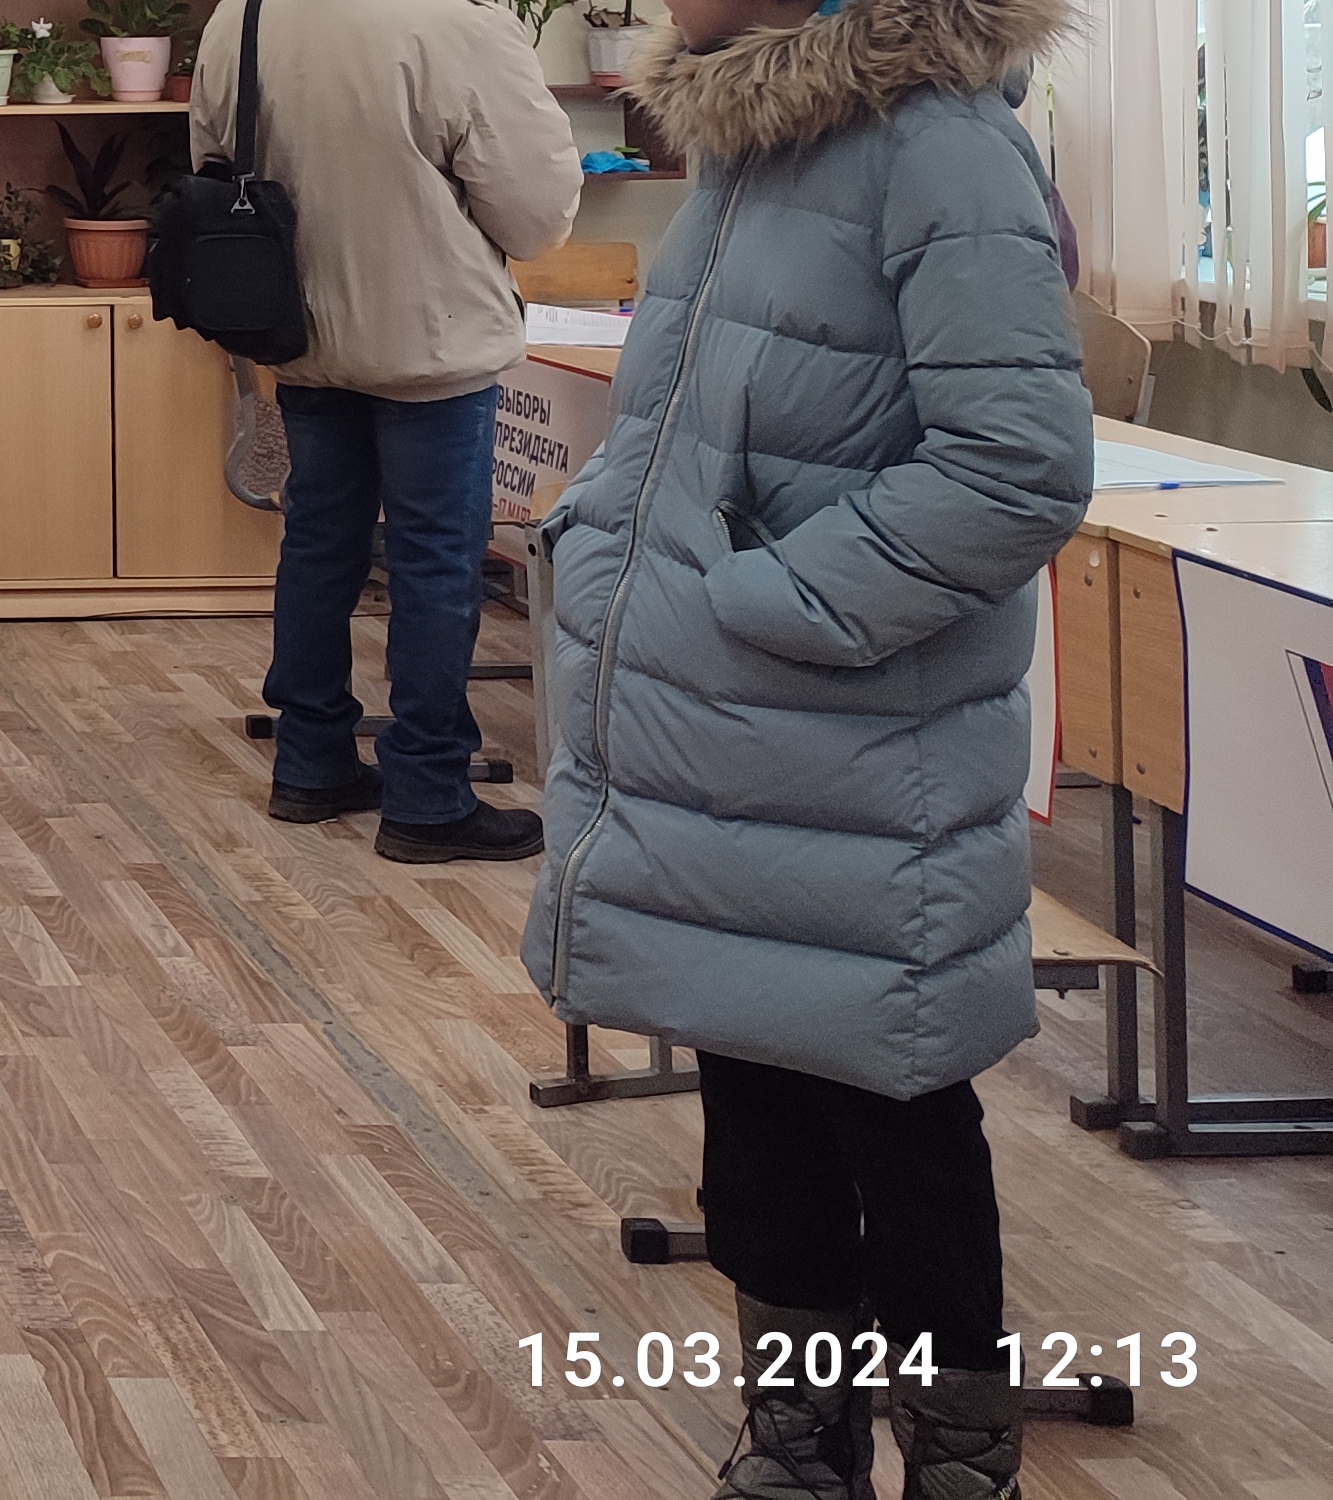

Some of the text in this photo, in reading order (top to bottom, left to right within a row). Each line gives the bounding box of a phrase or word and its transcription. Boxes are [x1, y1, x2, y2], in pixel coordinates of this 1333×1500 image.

[497, 385, 551, 426] ВЫБОРЫ
[494, 421, 570, 473] ПРЕЗИДЕНТА
[508, 501, 532, 522] МАРТ
